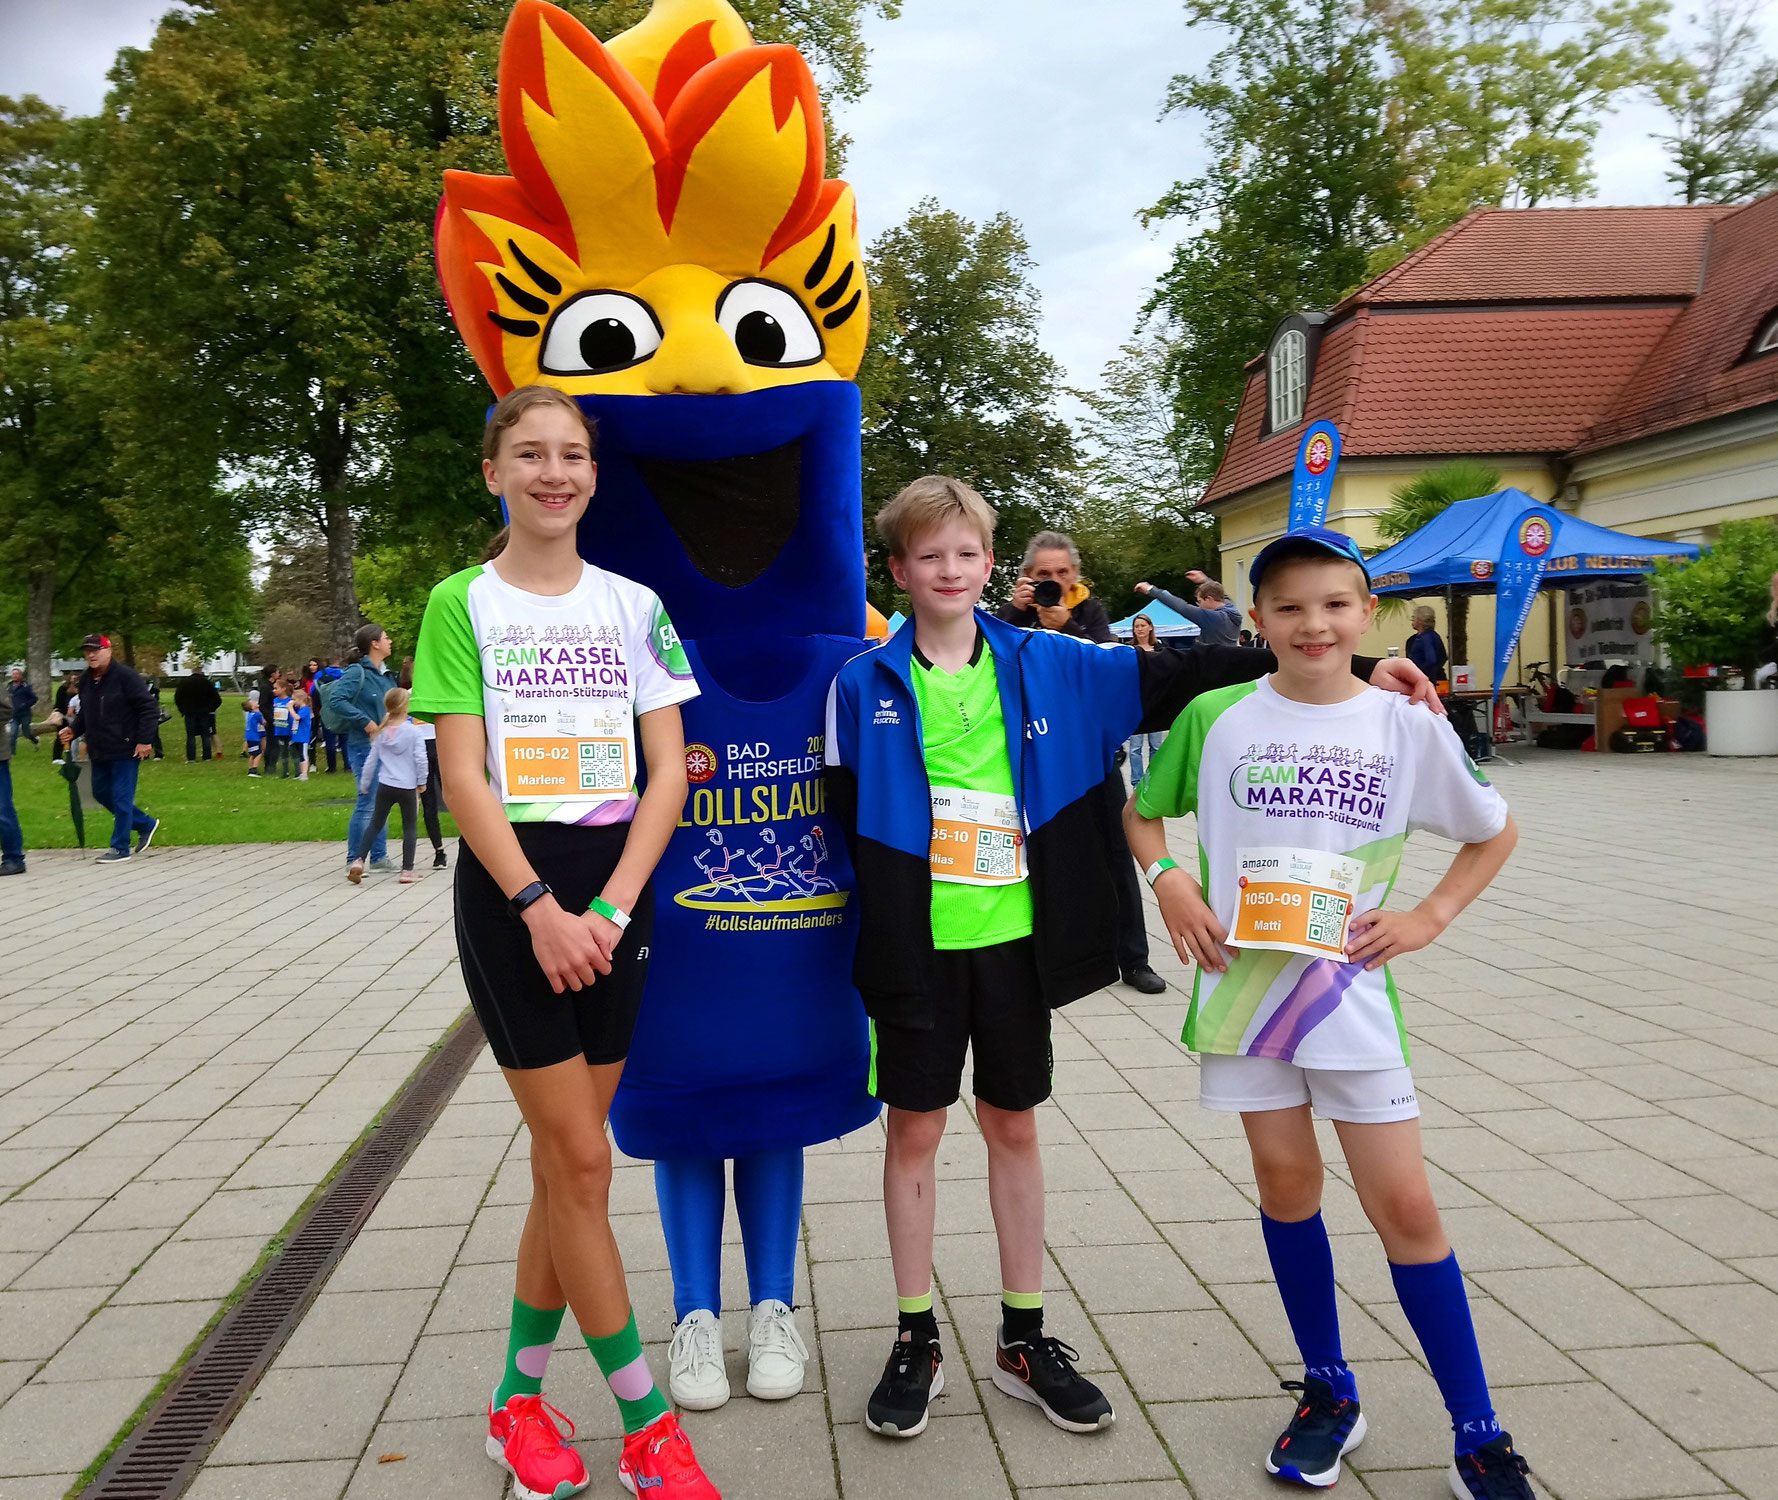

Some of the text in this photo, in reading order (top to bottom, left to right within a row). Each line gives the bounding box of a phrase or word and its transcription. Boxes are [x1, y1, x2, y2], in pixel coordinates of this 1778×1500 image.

[494, 647, 626, 666] EAMKASSEL
[496, 667, 628, 686] MARATHON
[515, 688, 629, 699] Marathon-Stützpunkt
[503, 714, 547, 723] amazon
[958, 702, 971, 733] KIPSTA
[512, 747, 570, 760] 1105-02
[727, 742, 770, 761] BAD
[728, 755, 825, 780] HERSFELDE
[518, 775, 566, 785] Marlene
[1247, 766, 1388, 798] EAMKASSEL
[1247, 787, 1385, 819] MARATHON
[1266, 808, 1381, 832] Marathon-Stützpunkt
[1242, 859, 1279, 869] amazon
[1245, 892, 1302, 907] 1050-09
[705, 911, 843, 931] #lollslaufmalanders
[1254, 920, 1282, 931] Matti
[1306, 1365, 1345, 1377] STA
[1463, 1420, 1501, 1433] KIP
